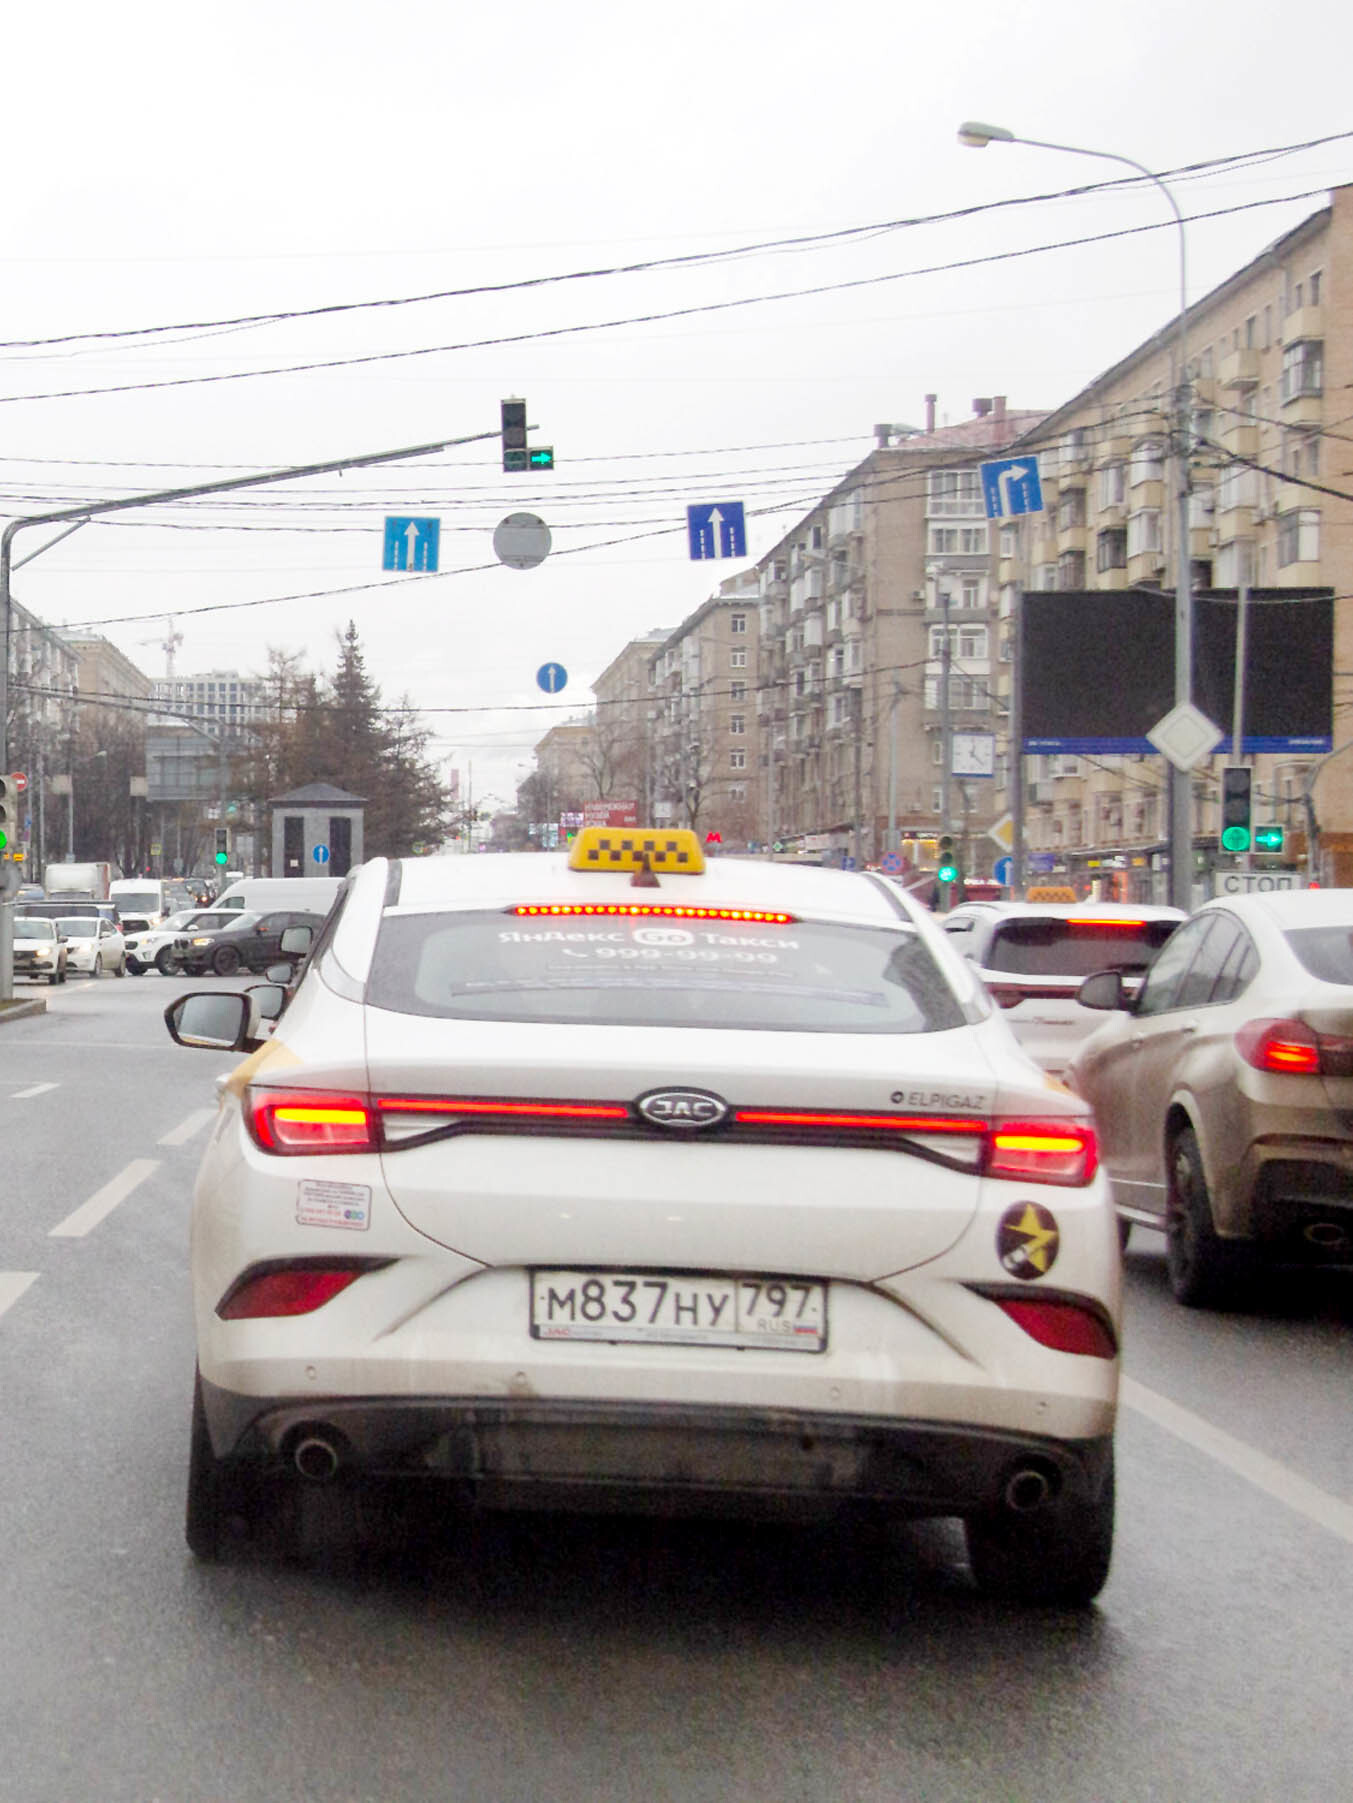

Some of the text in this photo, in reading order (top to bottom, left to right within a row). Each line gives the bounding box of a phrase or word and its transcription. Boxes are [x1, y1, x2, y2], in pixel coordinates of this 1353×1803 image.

[1224, 876, 1292, 893] СТОП
[498, 931, 625, 943] Яндекс
[700, 933, 799, 949] Такси
[595, 947, 778, 964] 999-99-99
[653, 1101, 713, 1117] JAC
[908, 1091, 985, 1110] ELPIGAZ
[742, 1282, 815, 1319] 797
[758, 1319, 792, 1332] RUS
